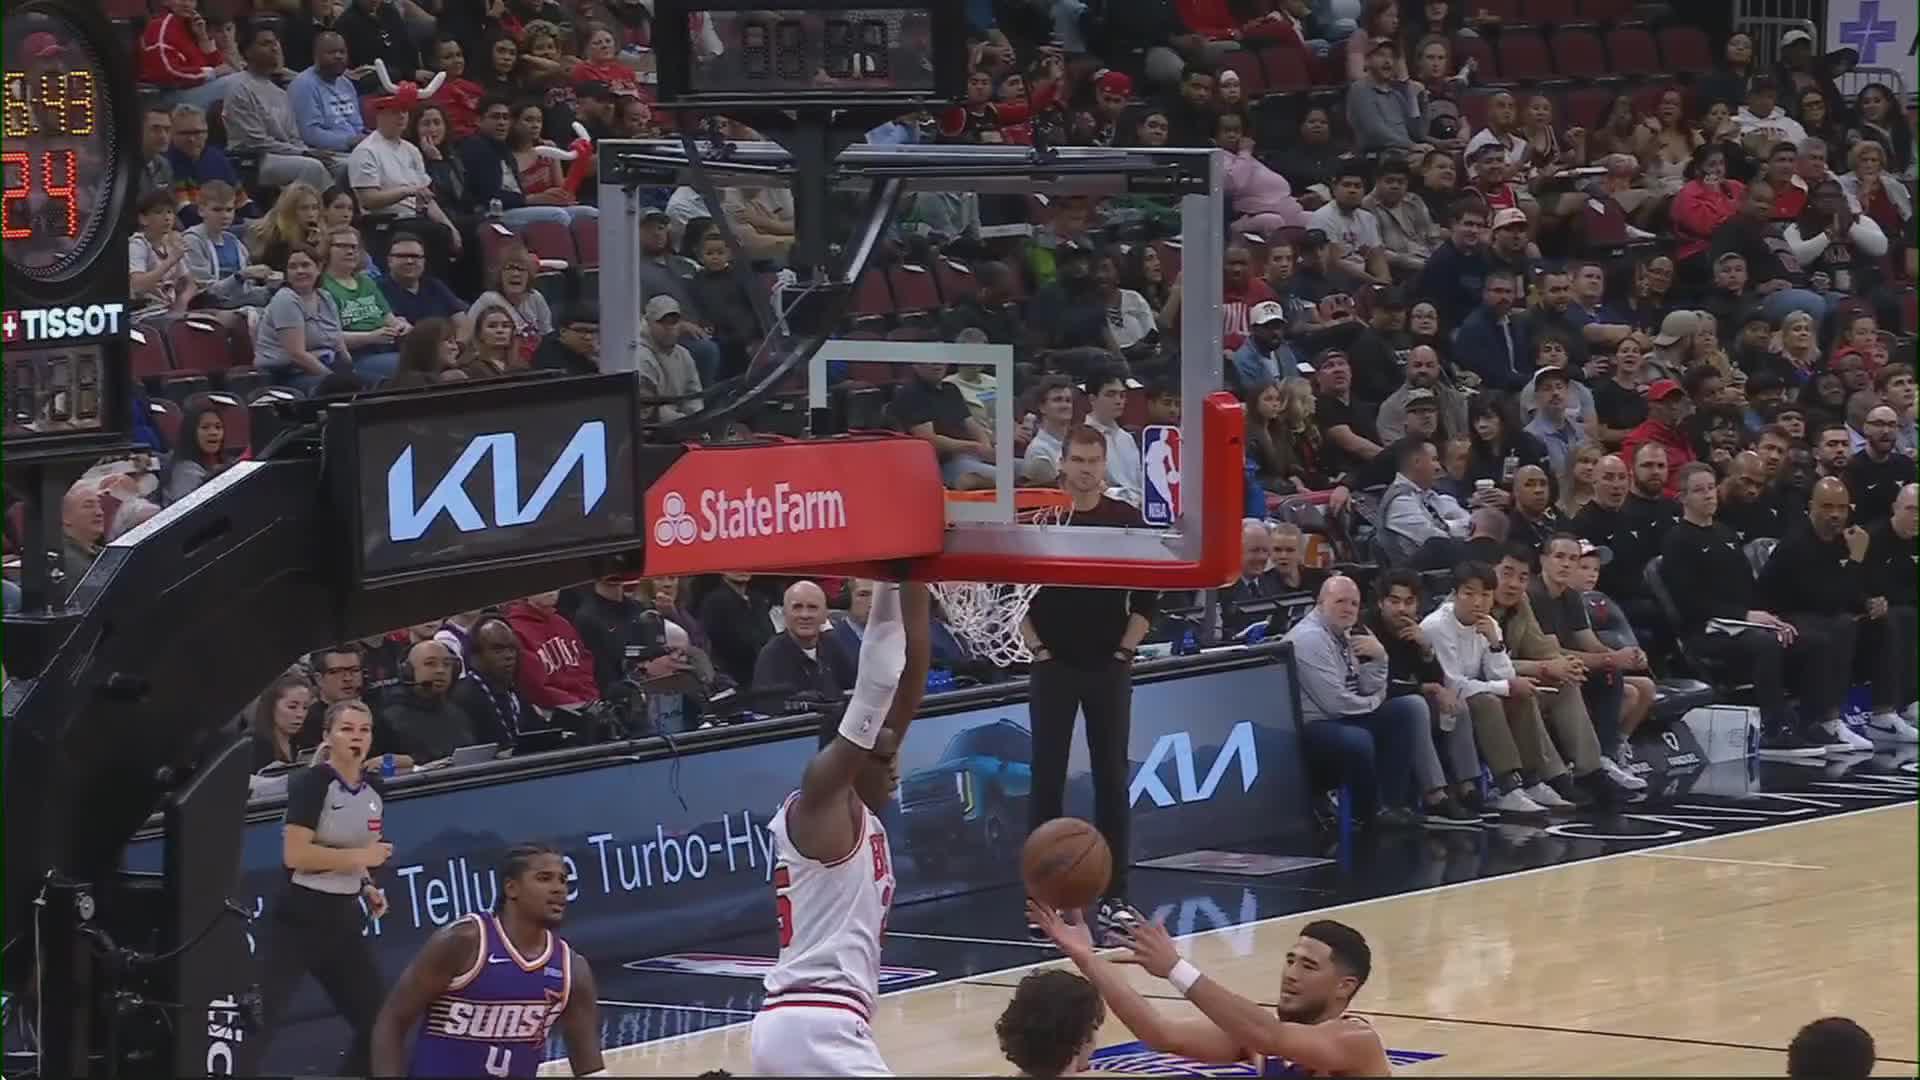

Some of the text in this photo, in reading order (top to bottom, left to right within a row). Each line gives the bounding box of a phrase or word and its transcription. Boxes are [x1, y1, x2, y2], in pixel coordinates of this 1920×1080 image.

[1, 152, 77, 239] 24
[20, 304, 123, 341] TISSOT
[388, 420, 607, 541] KIA
[588, 810, 774, 894] Turbo-Hy
[444, 1001, 545, 1038] SUNS
